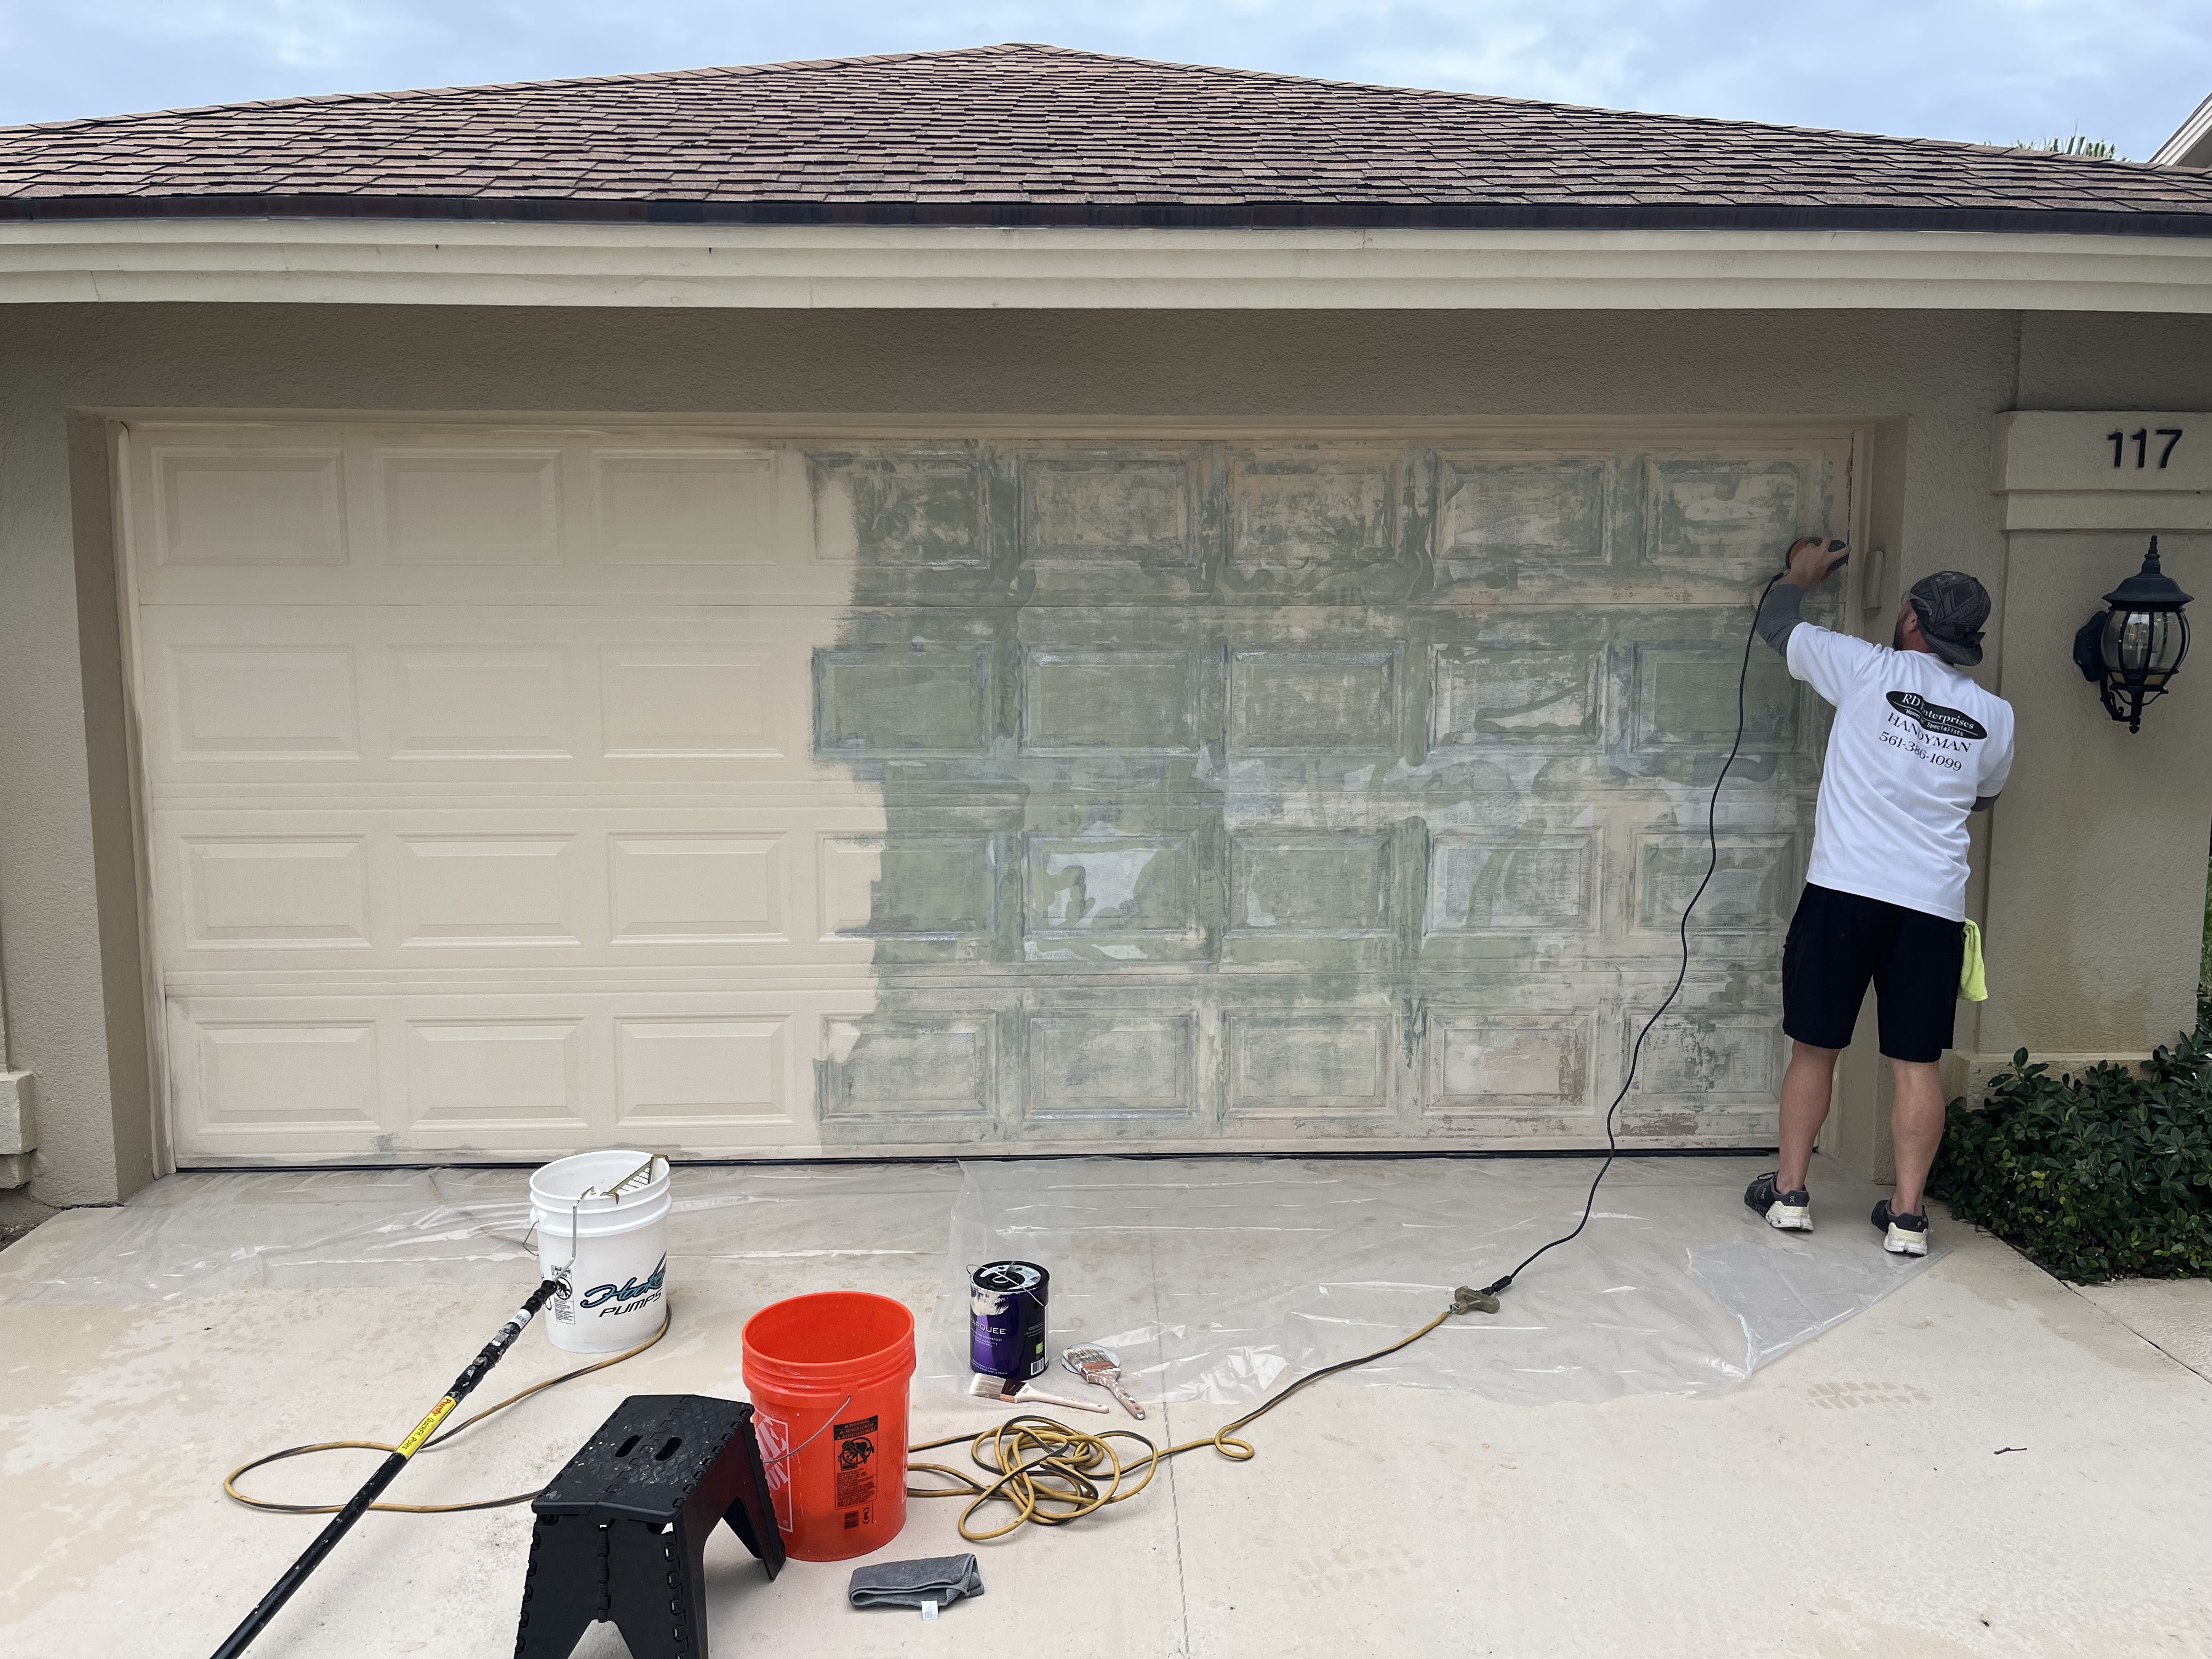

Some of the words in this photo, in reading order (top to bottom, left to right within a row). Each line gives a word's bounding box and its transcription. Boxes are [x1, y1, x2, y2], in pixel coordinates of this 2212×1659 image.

[2108, 428, 2183, 468] 117
[1902, 693, 1920, 706] RD
[1921, 702, 1974, 729] Enterprises
[1887, 712, 1971, 752] HANDYMAN
[1927, 722, 1963, 736] Specialists
[1879, 731, 1962, 771] 561-386-1099
[599, 1288, 662, 1317] PUMPS
[432, 1398, 452, 1416] Purdy
[402, 1437, 417, 1449] Poles
